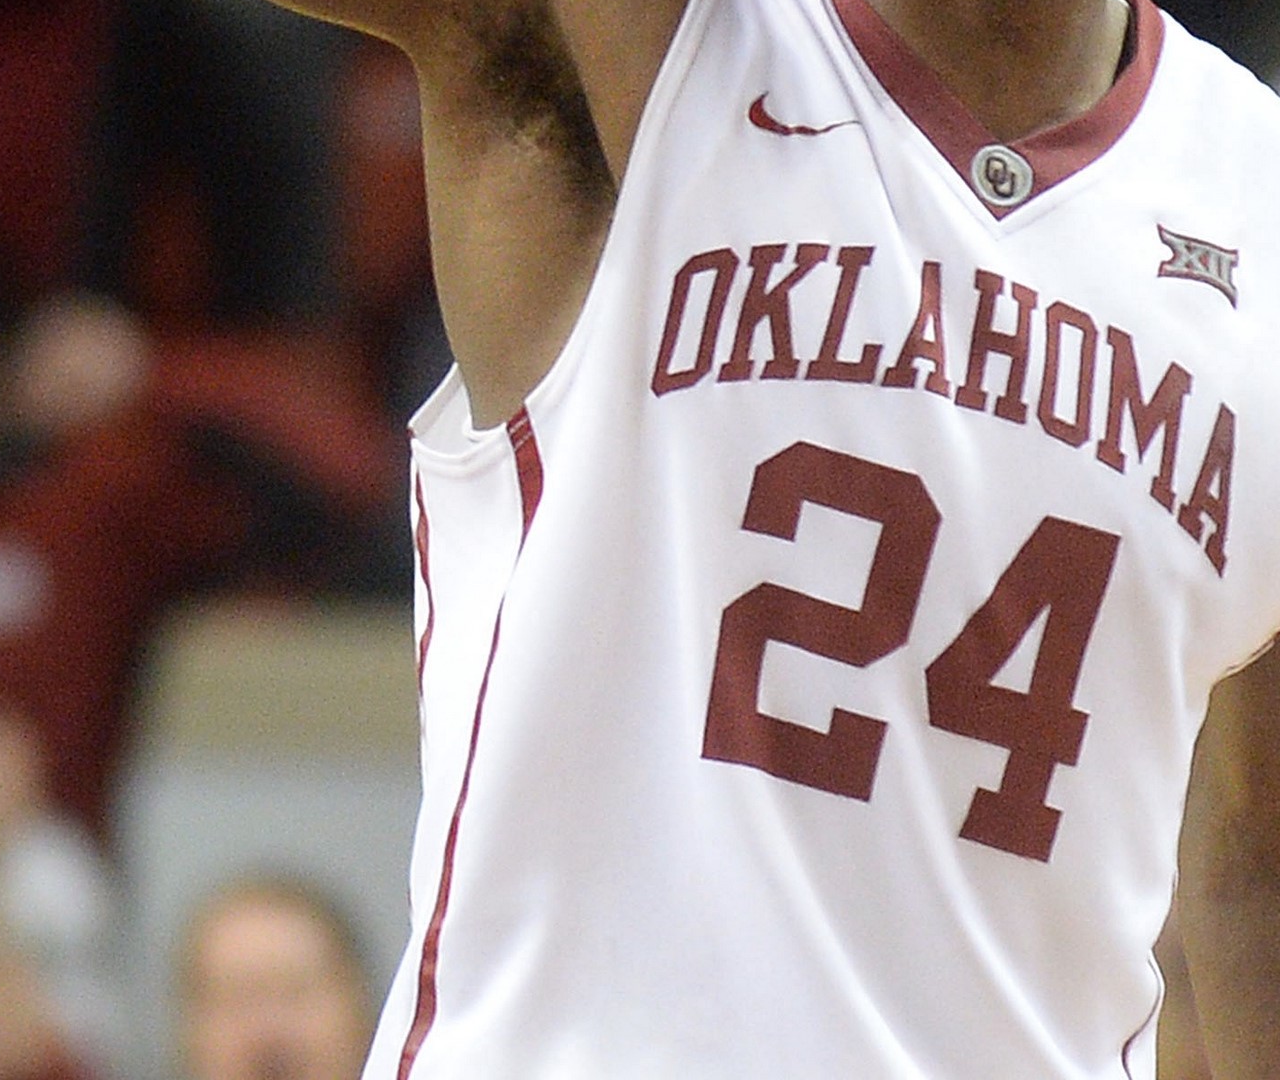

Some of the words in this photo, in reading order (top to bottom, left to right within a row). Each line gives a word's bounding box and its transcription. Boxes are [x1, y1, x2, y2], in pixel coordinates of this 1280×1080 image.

[985, 156, 1016, 199] OU
[652, 243, 1237, 577] OKLAHOMA
[701, 441, 1123, 863] 24
